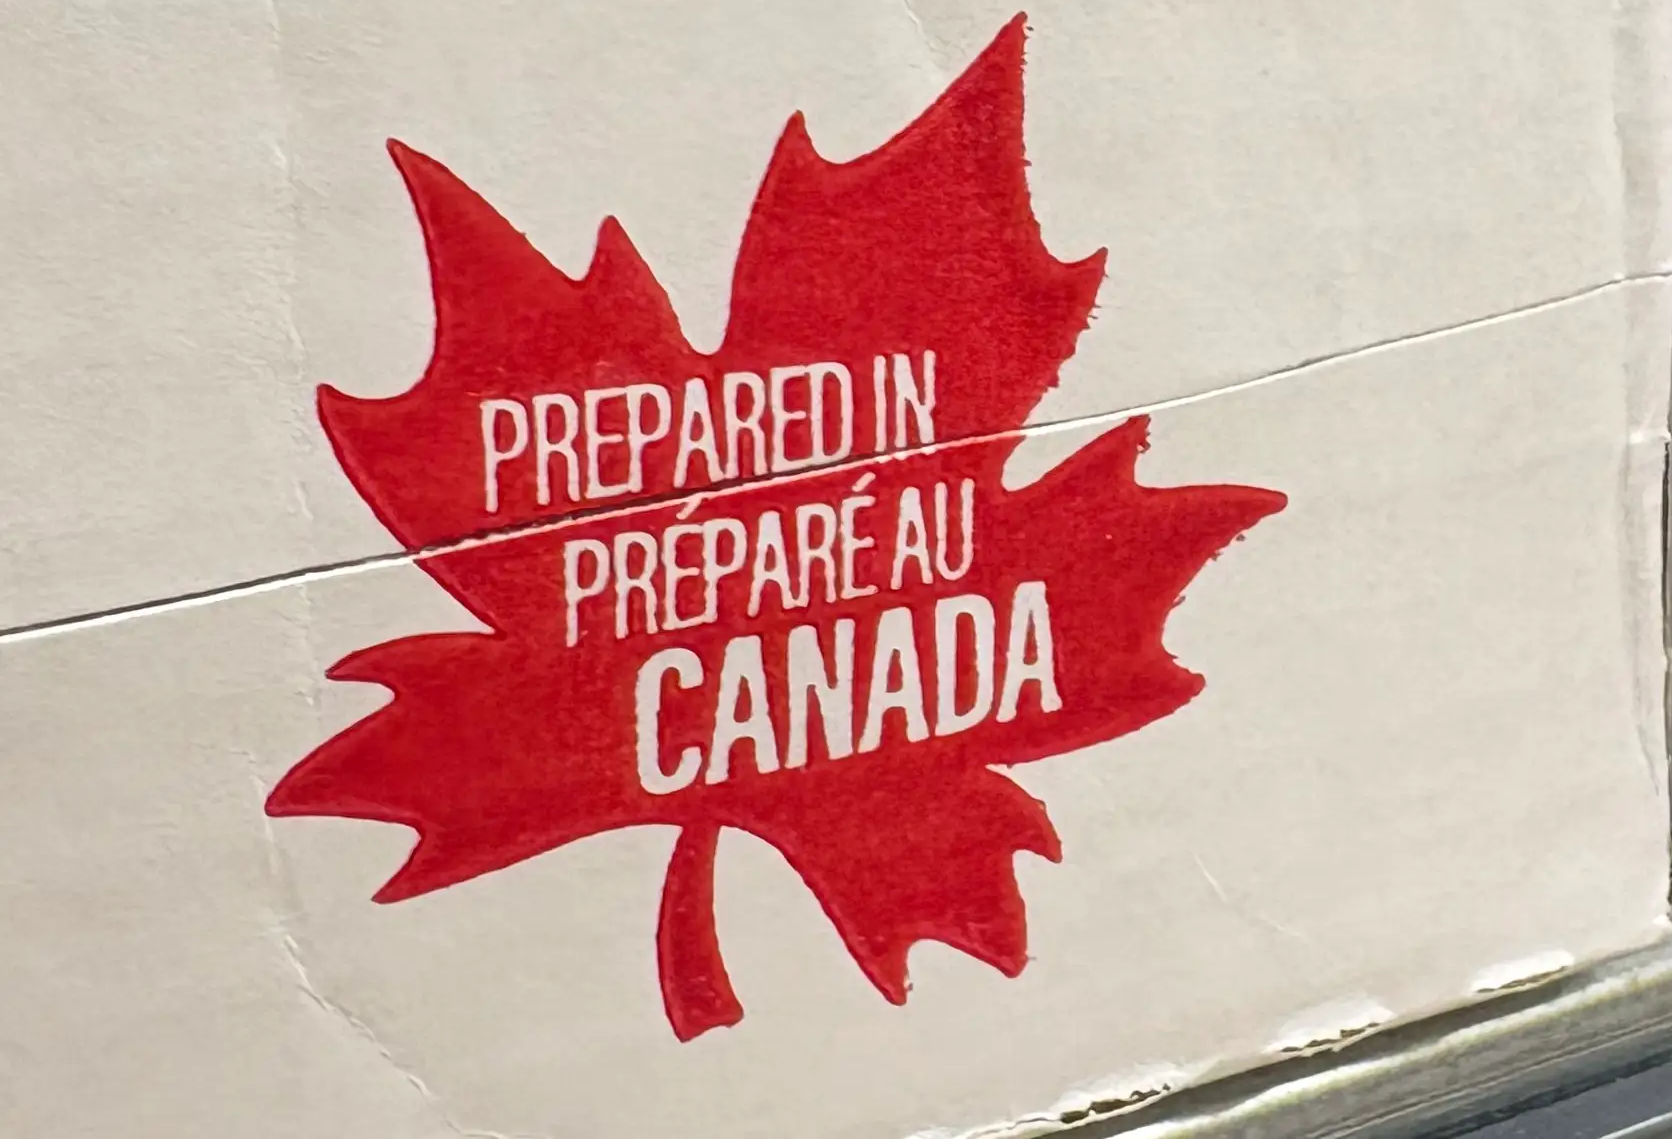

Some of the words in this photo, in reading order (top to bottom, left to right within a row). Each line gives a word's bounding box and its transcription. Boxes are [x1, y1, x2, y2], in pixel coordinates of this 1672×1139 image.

[480, 362, 854, 512] PREPARED
[873, 350, 937, 462] IN
[565, 473, 876, 647] PRÉPARÉ
[890, 479, 975, 590] AU
[635, 581, 1063, 794] CANADA
